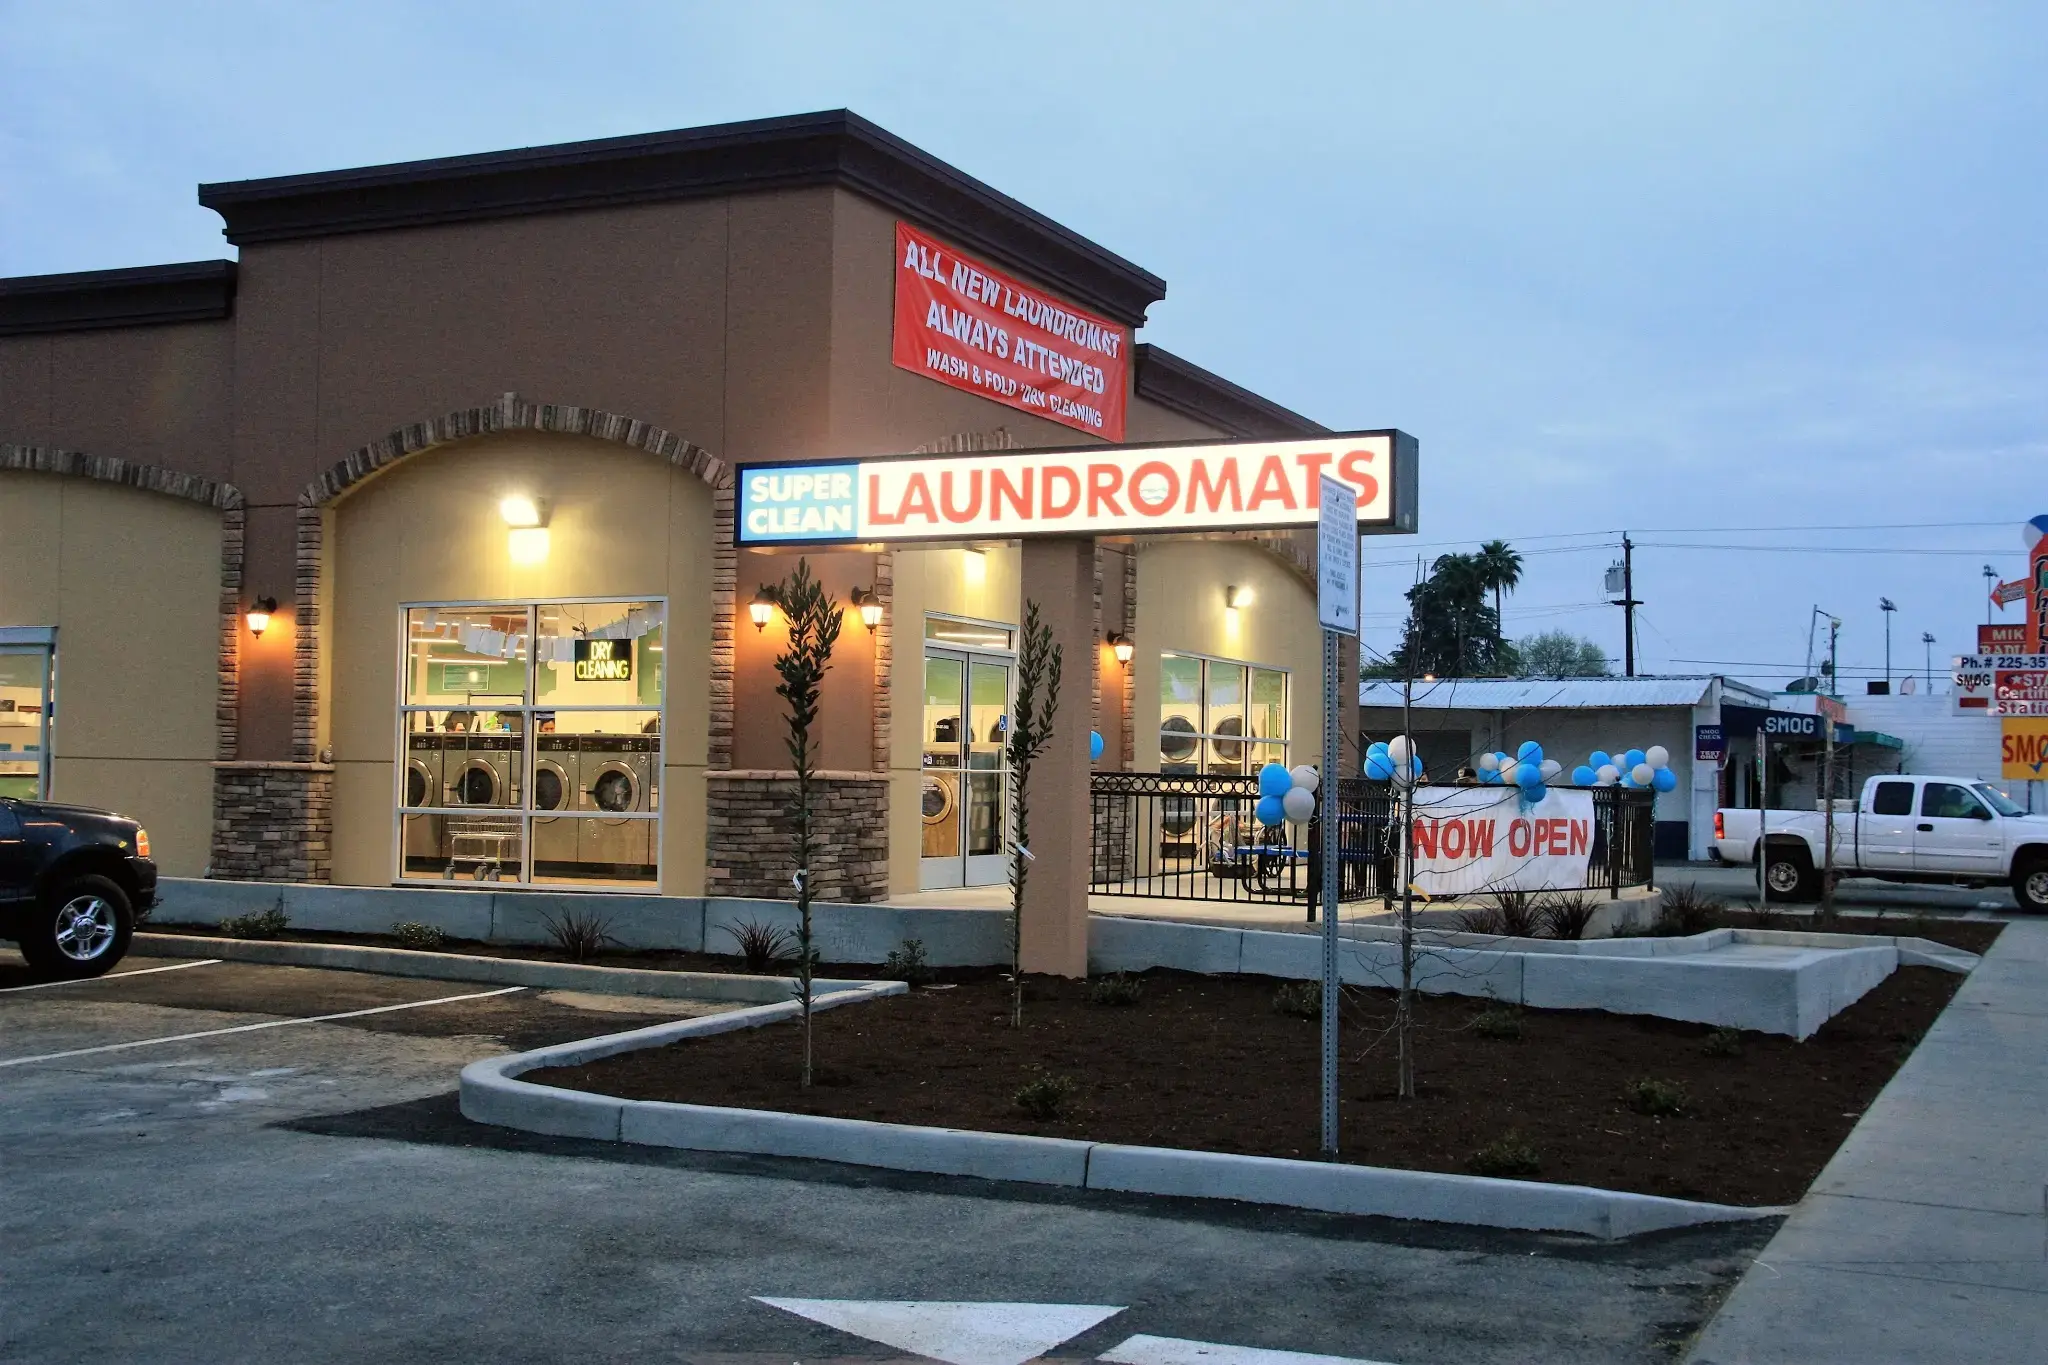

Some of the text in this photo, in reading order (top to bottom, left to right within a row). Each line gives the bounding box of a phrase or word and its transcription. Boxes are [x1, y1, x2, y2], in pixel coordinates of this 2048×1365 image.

[904, 240, 1121, 359] ALL NEW LAUNDROMAT
[926, 300, 1105, 395] ALWAYS ATTENDED
[926, 348, 968, 381] WASH
[972, 365, 982, 385] &
[985, 370, 1017, 397] FOLD
[1050, 394, 1103, 428] CLEANING
[749, 473, 851, 503] SUPER
[867, 451, 1379, 526] LAUNDROMATS
[748, 504, 852, 536] CLEAN
[590, 641, 614, 660] DRY
[1998, 657, 2048, 668] 225-35
[576, 660, 629, 679] CLEANING
[1957, 673, 1990, 686] SMOG
[1765, 717, 1815, 734] SMOG
[1413, 818, 1588, 860] NOW OPEN
